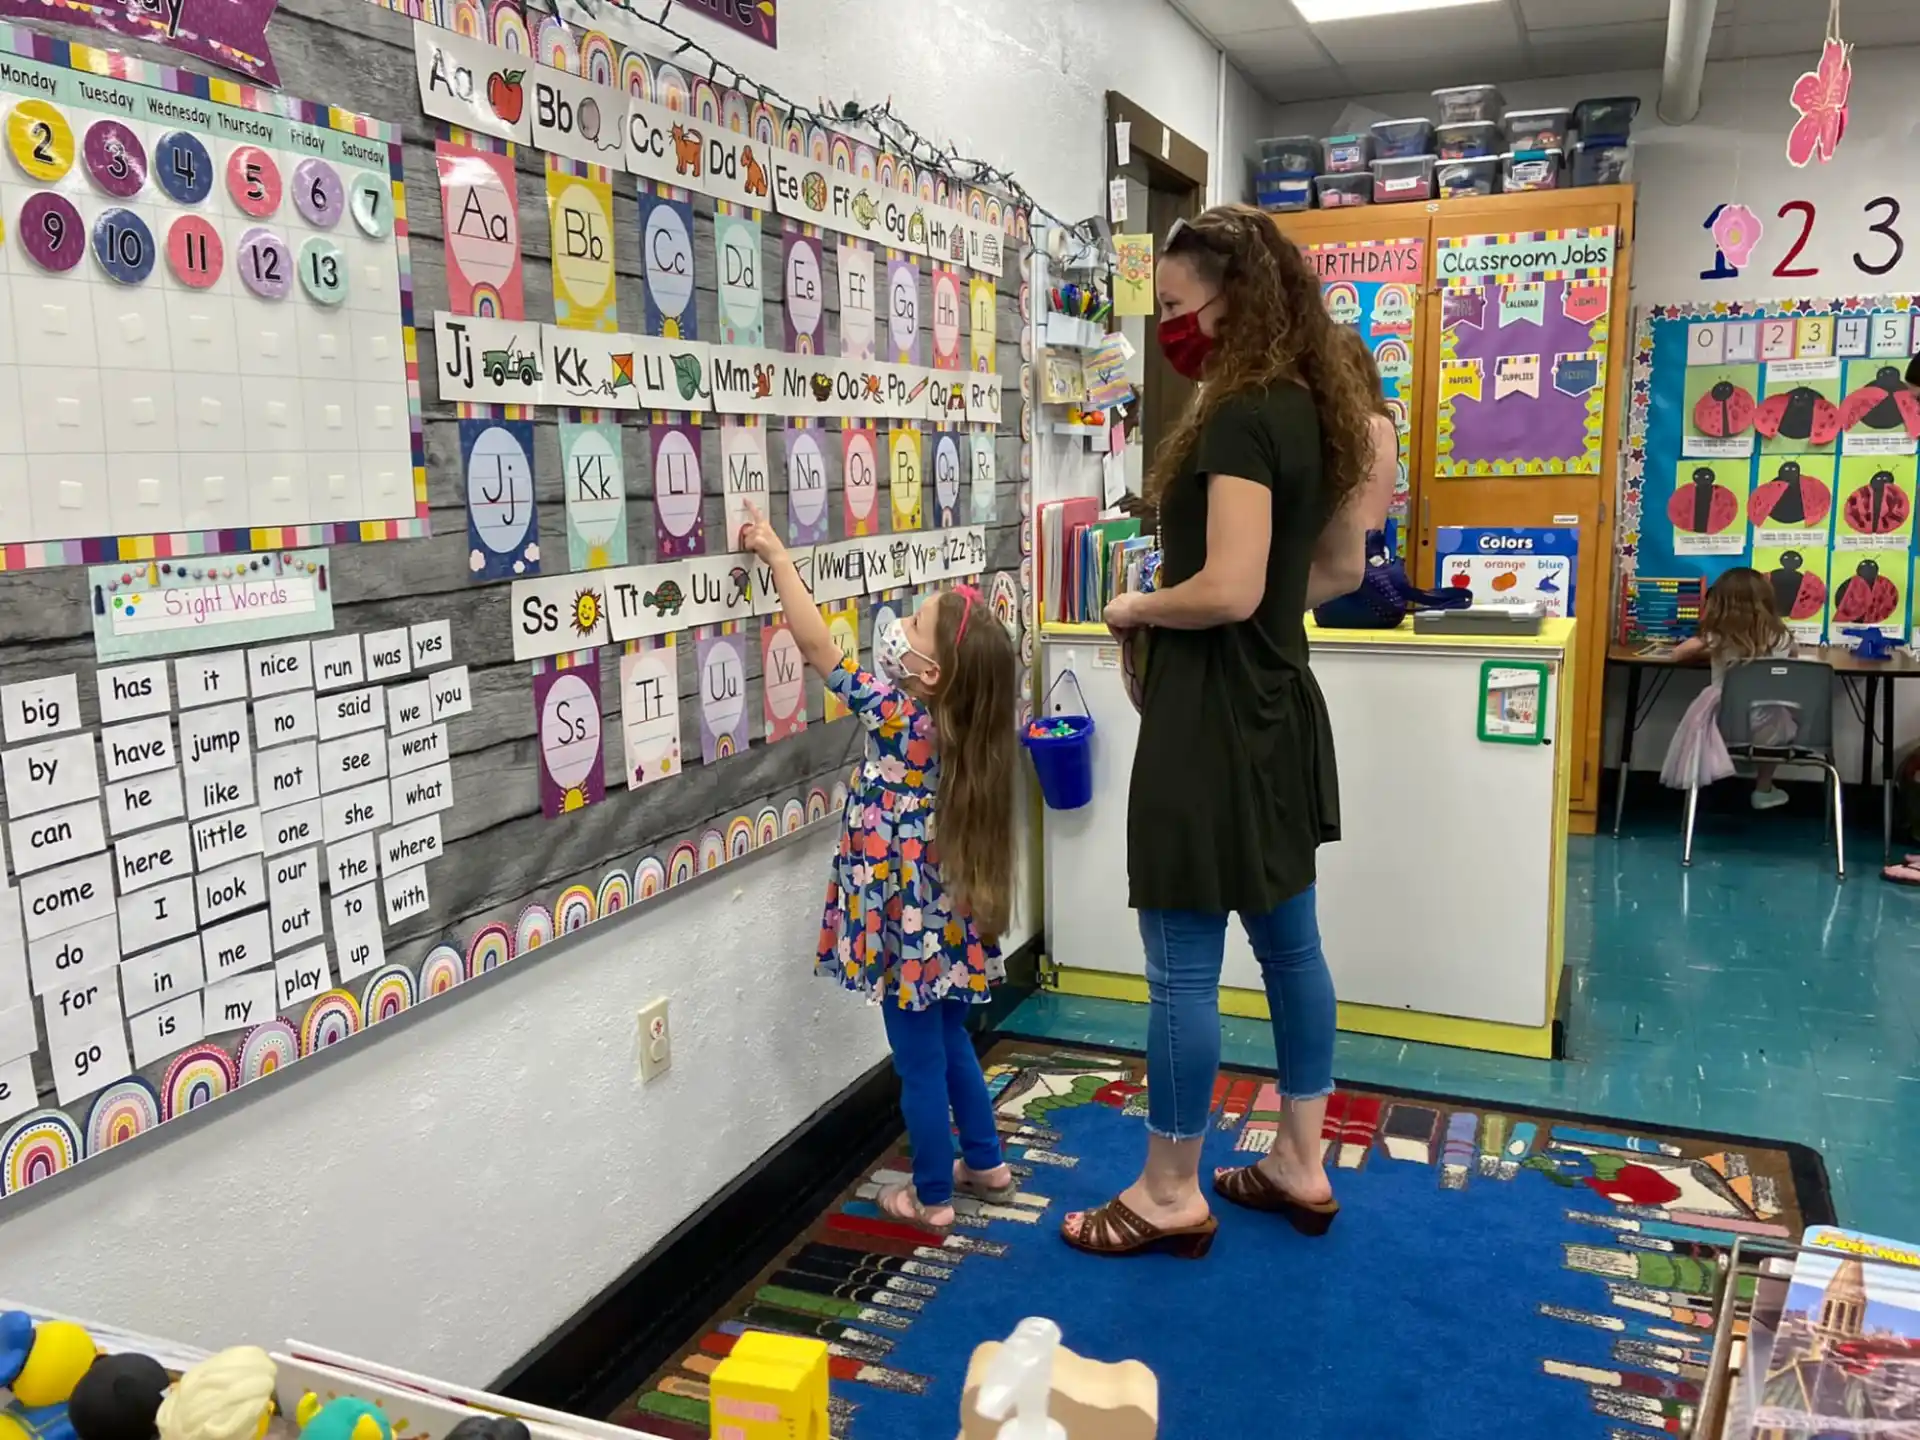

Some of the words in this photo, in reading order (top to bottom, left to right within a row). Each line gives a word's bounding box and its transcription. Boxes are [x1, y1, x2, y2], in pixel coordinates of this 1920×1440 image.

[429, 47, 474, 102] Aa
[1, 63, 57, 96] Monday
[79, 82, 134, 112] Tuesday
[147, 97, 212, 127] Wednesday
[217, 113, 273, 142] Thursday
[291, 129, 325, 153] Friday
[342, 141, 385, 165] Saturday
[536, 81, 573, 133] Bb
[629, 113, 665, 158] Cc
[31, 122, 55, 164] 2
[104, 140, 128, 178] 3
[173, 147, 196, 188] 4
[246, 164, 264, 201] 5
[310, 177, 328, 211] 6
[364, 189, 380, 218] 7
[710, 139, 737, 181] Dd
[775, 164, 799, 201] Ee
[457, 185, 508, 243] Aa
[833, 185, 851, 218] Ff
[564, 207, 604, 261] Bb
[885, 203, 905, 243] Gg
[930, 220, 947, 250] Hh
[1772, 200, 1819, 277] 2
[1853, 196, 1903, 275] 3
[42, 210, 65, 250] 9
[106, 223, 142, 268] 10
[185, 232, 209, 272] 11
[251, 244, 282, 282] 12
[311, 252, 339, 289] 13
[652, 228, 685, 276] Cc
[970, 230, 980, 257] Ii
[1443, 249, 1556, 273] Classroom
[1562, 244, 1607, 266] Jobs
[725, 243, 754, 288] Dd
[793, 260, 815, 300] Ee
[849, 272, 866, 308] Ff
[893, 283, 915, 334] Gg
[938, 291, 955, 326] Hh
[1697, 329, 1713, 347] 0
[1738, 326, 1744, 345] 1
[1772, 325, 1785, 344] 2
[1808, 323, 1821, 342] 3
[1844, 321, 1859, 340] 4
[1884, 320, 1897, 339] 5
[445, 322, 474, 389] Jj
[553, 346, 593, 387] Kk
[643, 354, 664, 391] Ll
[714, 358, 750, 393] Mm
[783, 367, 807, 397] Nn
[837, 371, 859, 401] Oo
[888, 373, 906, 407] Pp
[929, 381, 948, 421] Qq
[971, 383, 985, 408] Rr
[576, 455, 612, 500] Kk
[667, 453, 688, 495] Ll
[728, 453, 764, 493] Mm
[796, 454, 821, 491] Nn
[851, 452, 871, 486] Oo
[898, 451, 915, 497] Pp
[939, 452, 955, 495] Qq
[978, 452, 990, 478] Rr
[482, 455, 515, 525] Jj
[950, 538, 966, 562] Zz
[1479, 535, 1533, 549] Colors
[818, 551, 844, 580] Ww
[867, 551, 886, 577] Xx
[912, 544, 928, 575] Yy
[1452, 559, 1471, 568] red
[1484, 560, 1526, 570] orange
[1537, 559, 1564, 569] blue
[165, 585, 223, 623] Sight
[229, 584, 287, 611] Words
[614, 584, 638, 617] Tt
[692, 573, 720, 605] Uu
[522, 596, 558, 635] Ss
[372, 647, 402, 668] was
[417, 634, 443, 658] yes
[260, 653, 298, 677] nice
[324, 658, 353, 679] run
[772, 648, 794, 685] Vv
[113, 674, 152, 701] has
[203, 669, 220, 692] it
[709, 665, 737, 702] Uu
[337, 695, 372, 719] said
[435, 684, 462, 709] you
[636, 679, 663, 722] Tt
[22, 699, 60, 727] big
[274, 712, 296, 732] no
[399, 704, 420, 724] we
[556, 702, 586, 745] Ss
[113, 737, 166, 766] have
[191, 727, 240, 762] jump
[402, 732, 438, 757] went
[29, 757, 58, 786] by
[342, 750, 372, 771] see
[273, 767, 303, 791] not
[406, 782, 443, 806] what
[124, 787, 152, 811] he
[203, 782, 240, 807] like
[345, 802, 375, 826] she
[30, 821, 72, 850] can
[197, 822, 248, 852] little
[277, 821, 310, 845] one
[389, 833, 437, 864] where
[123, 849, 174, 879] here
[277, 861, 307, 884] our
[339, 858, 368, 881] the
[32, 881, 94, 916] come
[207, 877, 247, 908] look
[345, 897, 363, 917] to
[391, 886, 425, 913] with
[155, 897, 168, 920] I
[281, 908, 311, 933] out
[55, 944, 84, 970] do
[218, 942, 247, 967] me
[350, 945, 370, 966] up
[154, 971, 173, 992] in
[284, 966, 322, 1000] play
[60, 983, 98, 1017] for
[225, 998, 252, 1022] my
[158, 1018, 176, 1037] is
[74, 1045, 102, 1076] go
